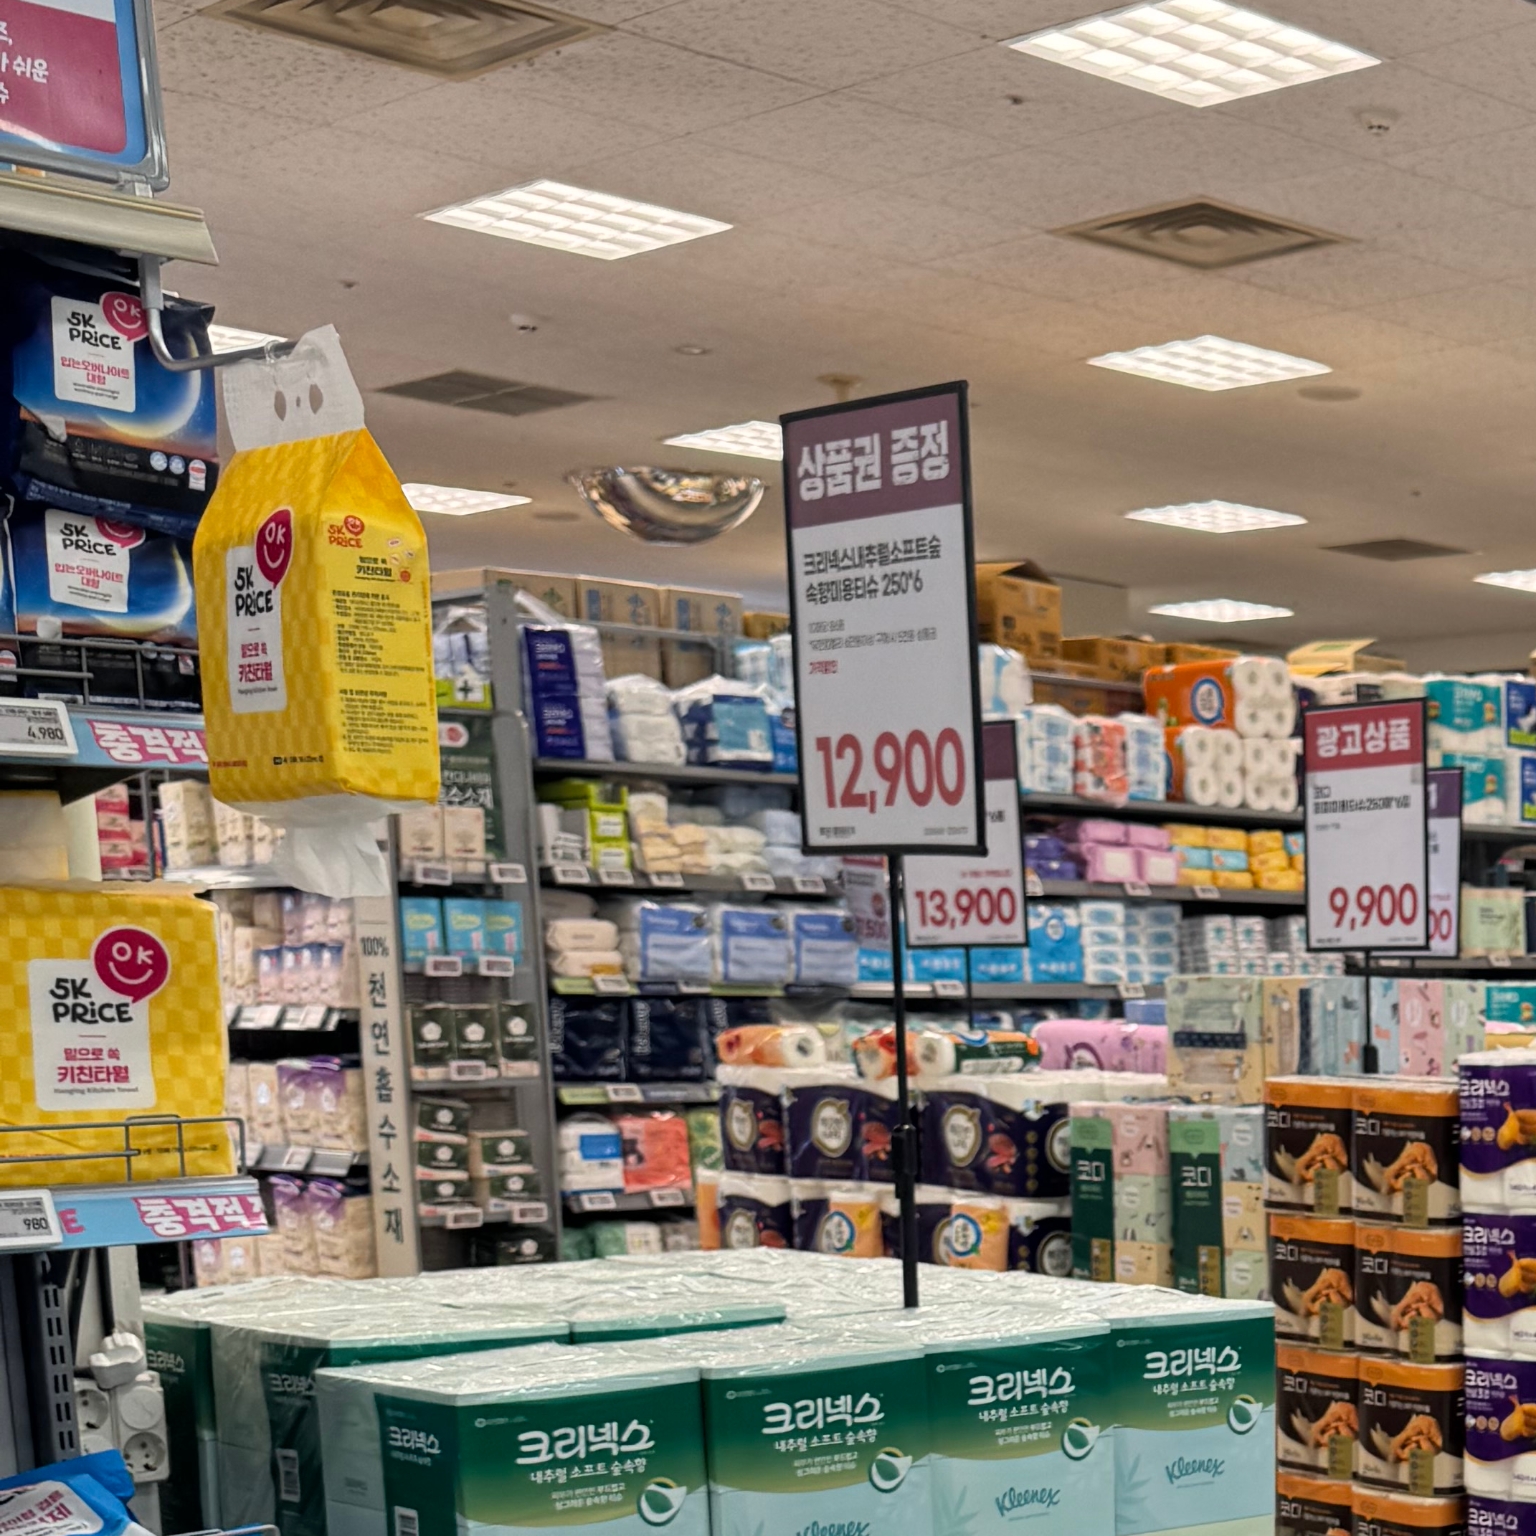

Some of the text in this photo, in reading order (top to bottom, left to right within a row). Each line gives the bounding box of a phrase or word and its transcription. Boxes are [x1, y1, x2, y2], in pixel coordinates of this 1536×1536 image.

[12, 55, 49, 84] 쉬운
[67, 311, 96, 329] 5K
[114, 298, 142, 318] OK
[797, 419, 950, 501] 상품권 증정
[59, 523, 89, 538] 5K
[265, 522, 286, 545] OK
[234, 565, 254, 591] 5K
[1316, 718, 1411, 759] 광고상품
[815, 727, 966, 814] 12,900
[914, 887, 1017, 930] 13,900
[1329, 883, 1418, 931] 9,900
[112, 941, 154, 965] OK
[49, 978, 92, 999] 5K
[57, 1065, 130, 1084] 키친타월
[1181, 1165, 1212, 1188] 코디
[142, 1197, 247, 1237] 충격적
[1463, 1225, 1515, 1246] 크리넥스
[1361, 1256, 1388, 1275] 코디
[1143, 1346, 1242, 1379] 크리넥스
[968, 1367, 1076, 1405] 크리넥스
[1283, 1375, 1308, 1393] 코디
[1465, 1368, 1518, 1389] 크리넥스
[1364, 1386, 1387, 1406] 코디
[761, 1393, 885, 1434] 크리넥스
[387, 1426, 442, 1455] 크리넥스
[515, 1419, 656, 1465] 크리넥스
[1165, 1456, 1226, 1484] Kleenex
[994, 1487, 1061, 1517] Kleenex
[1468, 1507, 1518, 1530] 크리넥스
